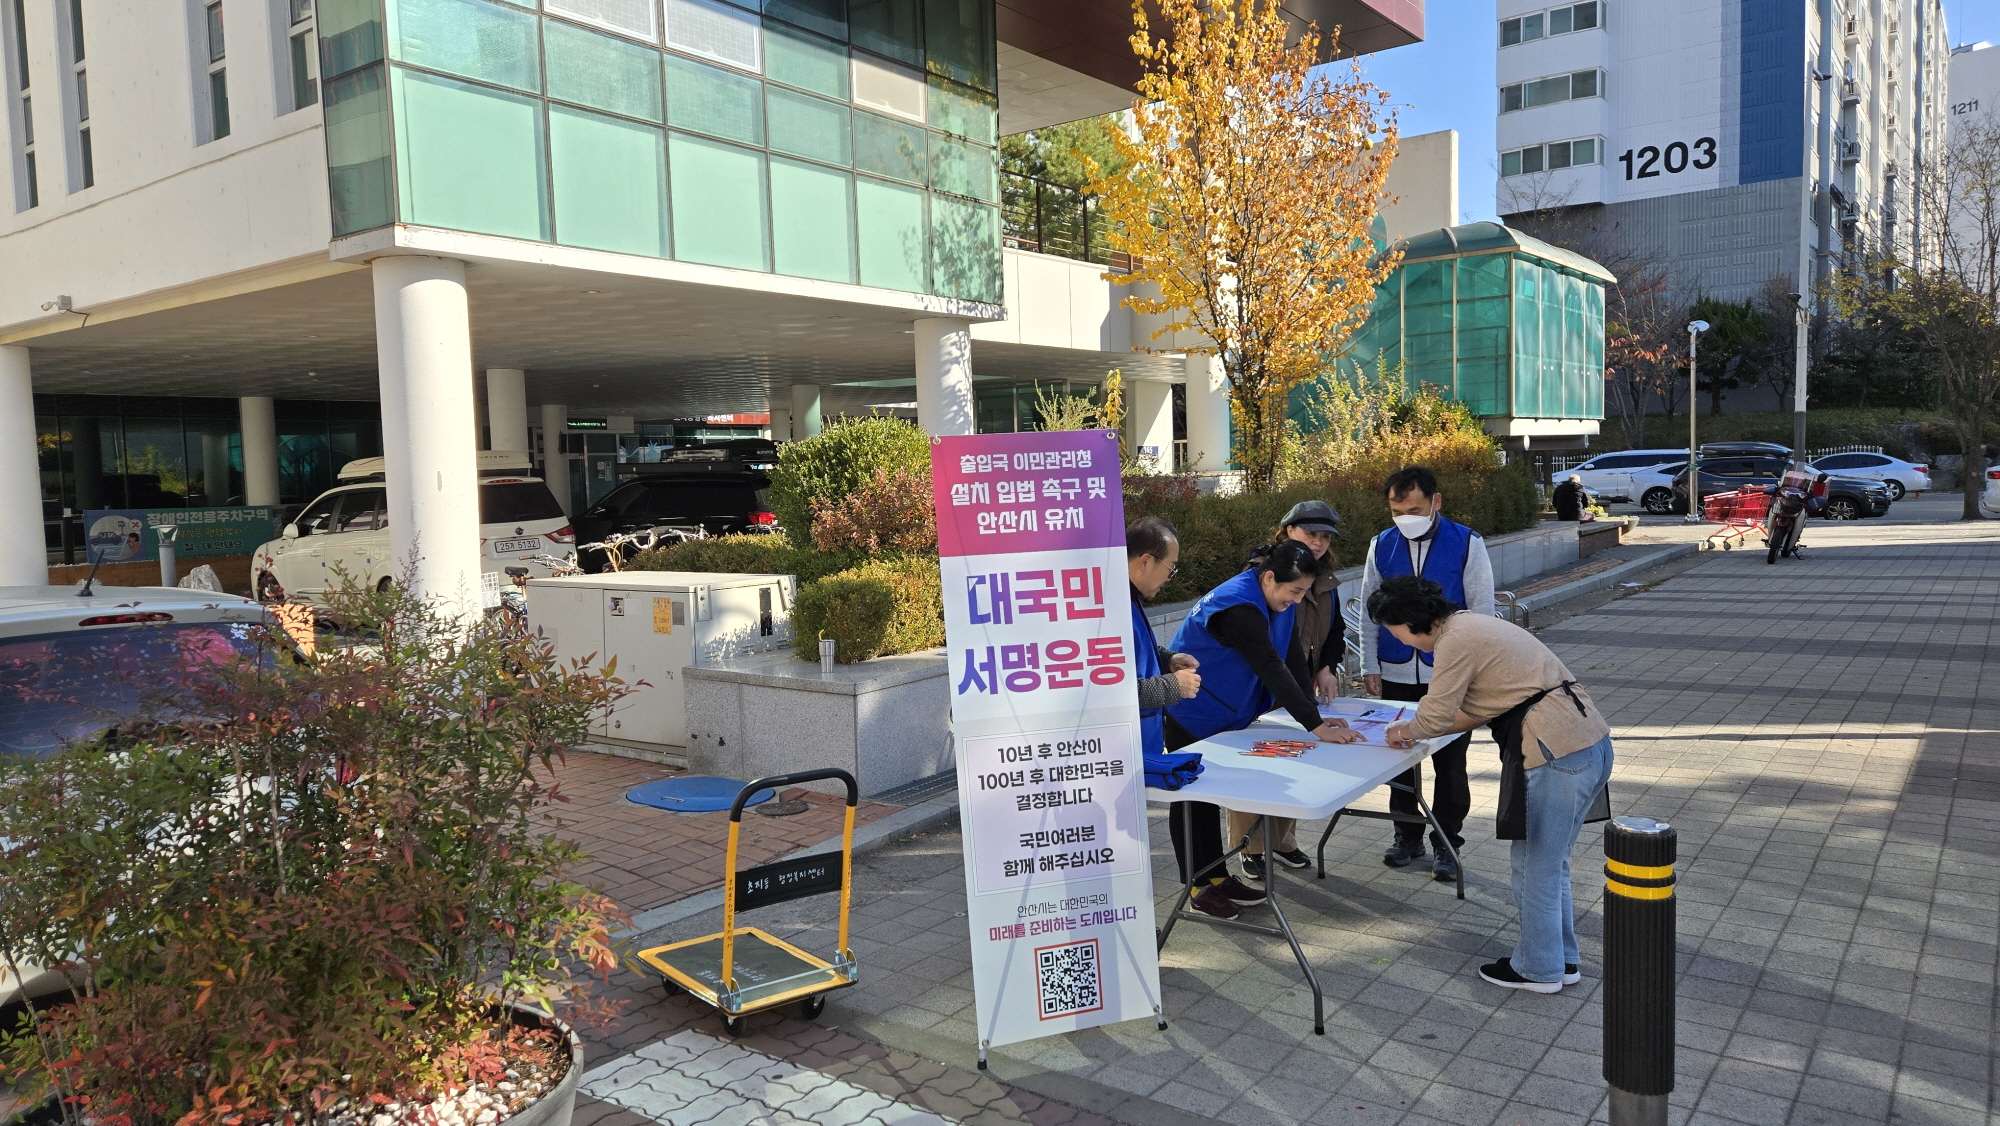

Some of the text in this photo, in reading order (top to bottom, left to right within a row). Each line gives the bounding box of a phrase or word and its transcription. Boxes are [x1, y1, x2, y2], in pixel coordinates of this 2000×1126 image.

[1951, 100, 1978, 115] 1211
[1619, 137, 1717, 180] 1203
[960, 450, 1092, 473] 출입국 이민관리청
[951, 477, 1107, 506] 설치 입법 촉구 및
[146, 509, 269, 525] 장애인전용주차구역
[977, 507, 1084, 534] 안산시 유치
[518, 540, 536, 549] 5132
[966, 566, 1105, 625] 대국민
[958, 636, 1126, 695] 서명운동
[998, 738, 1101, 763] 10년 후 안산이
[978, 760, 1124, 790] 100년 후 대한민국을
[1016, 787, 1093, 811] 결정합니다
[1020, 825, 1096, 848] 국민여러분
[1003, 847, 1115, 877] 함께 해주십시오
[1017, 893, 1108, 918] 안산시는 대한민국의
[989, 906, 1137, 941] 미래를 준비하는 도시입니다
